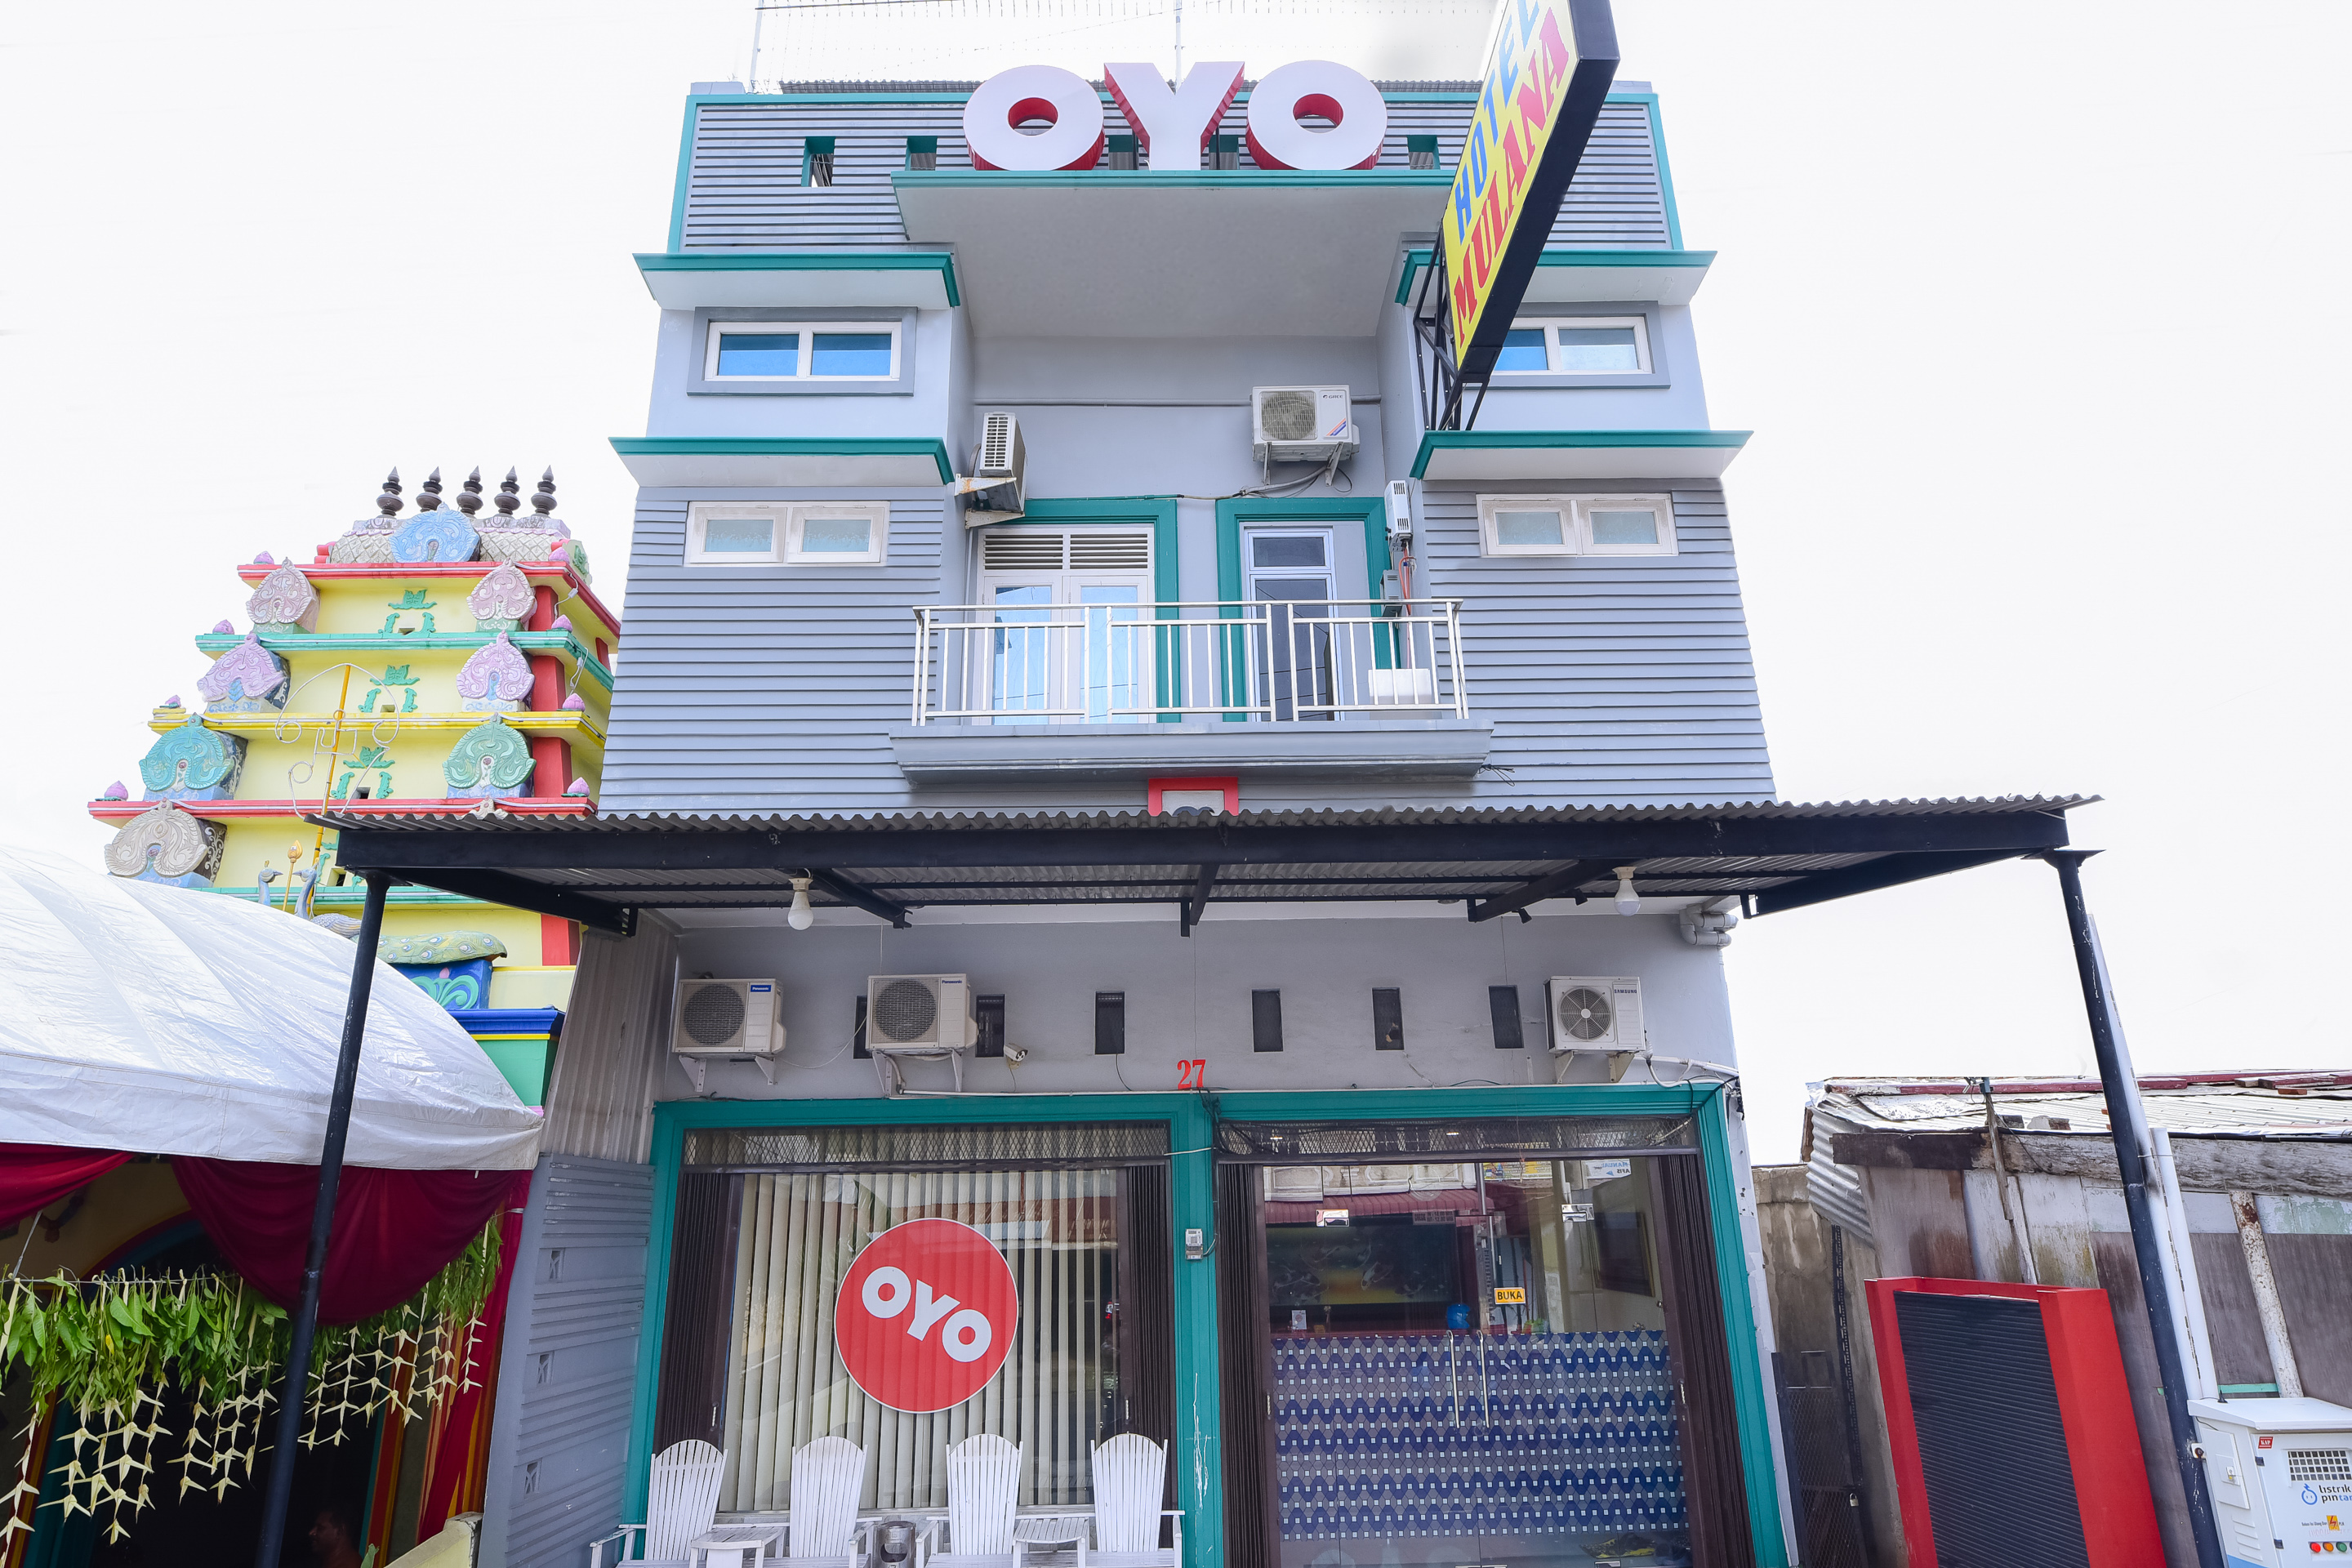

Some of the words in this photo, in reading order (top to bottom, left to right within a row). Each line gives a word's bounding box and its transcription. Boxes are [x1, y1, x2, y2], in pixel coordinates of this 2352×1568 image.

[964, 60, 1388, 171] OYO
[1455, 0, 1539, 245] HOTEL
[1454, 7, 1569, 349] MULANA
[1177, 1058, 1206, 1090] 27
[862, 1265, 992, 1363] OYO
[1497, 1290, 1523, 1300] BUKA
[2319, 1484, 2351, 1494] listrik
